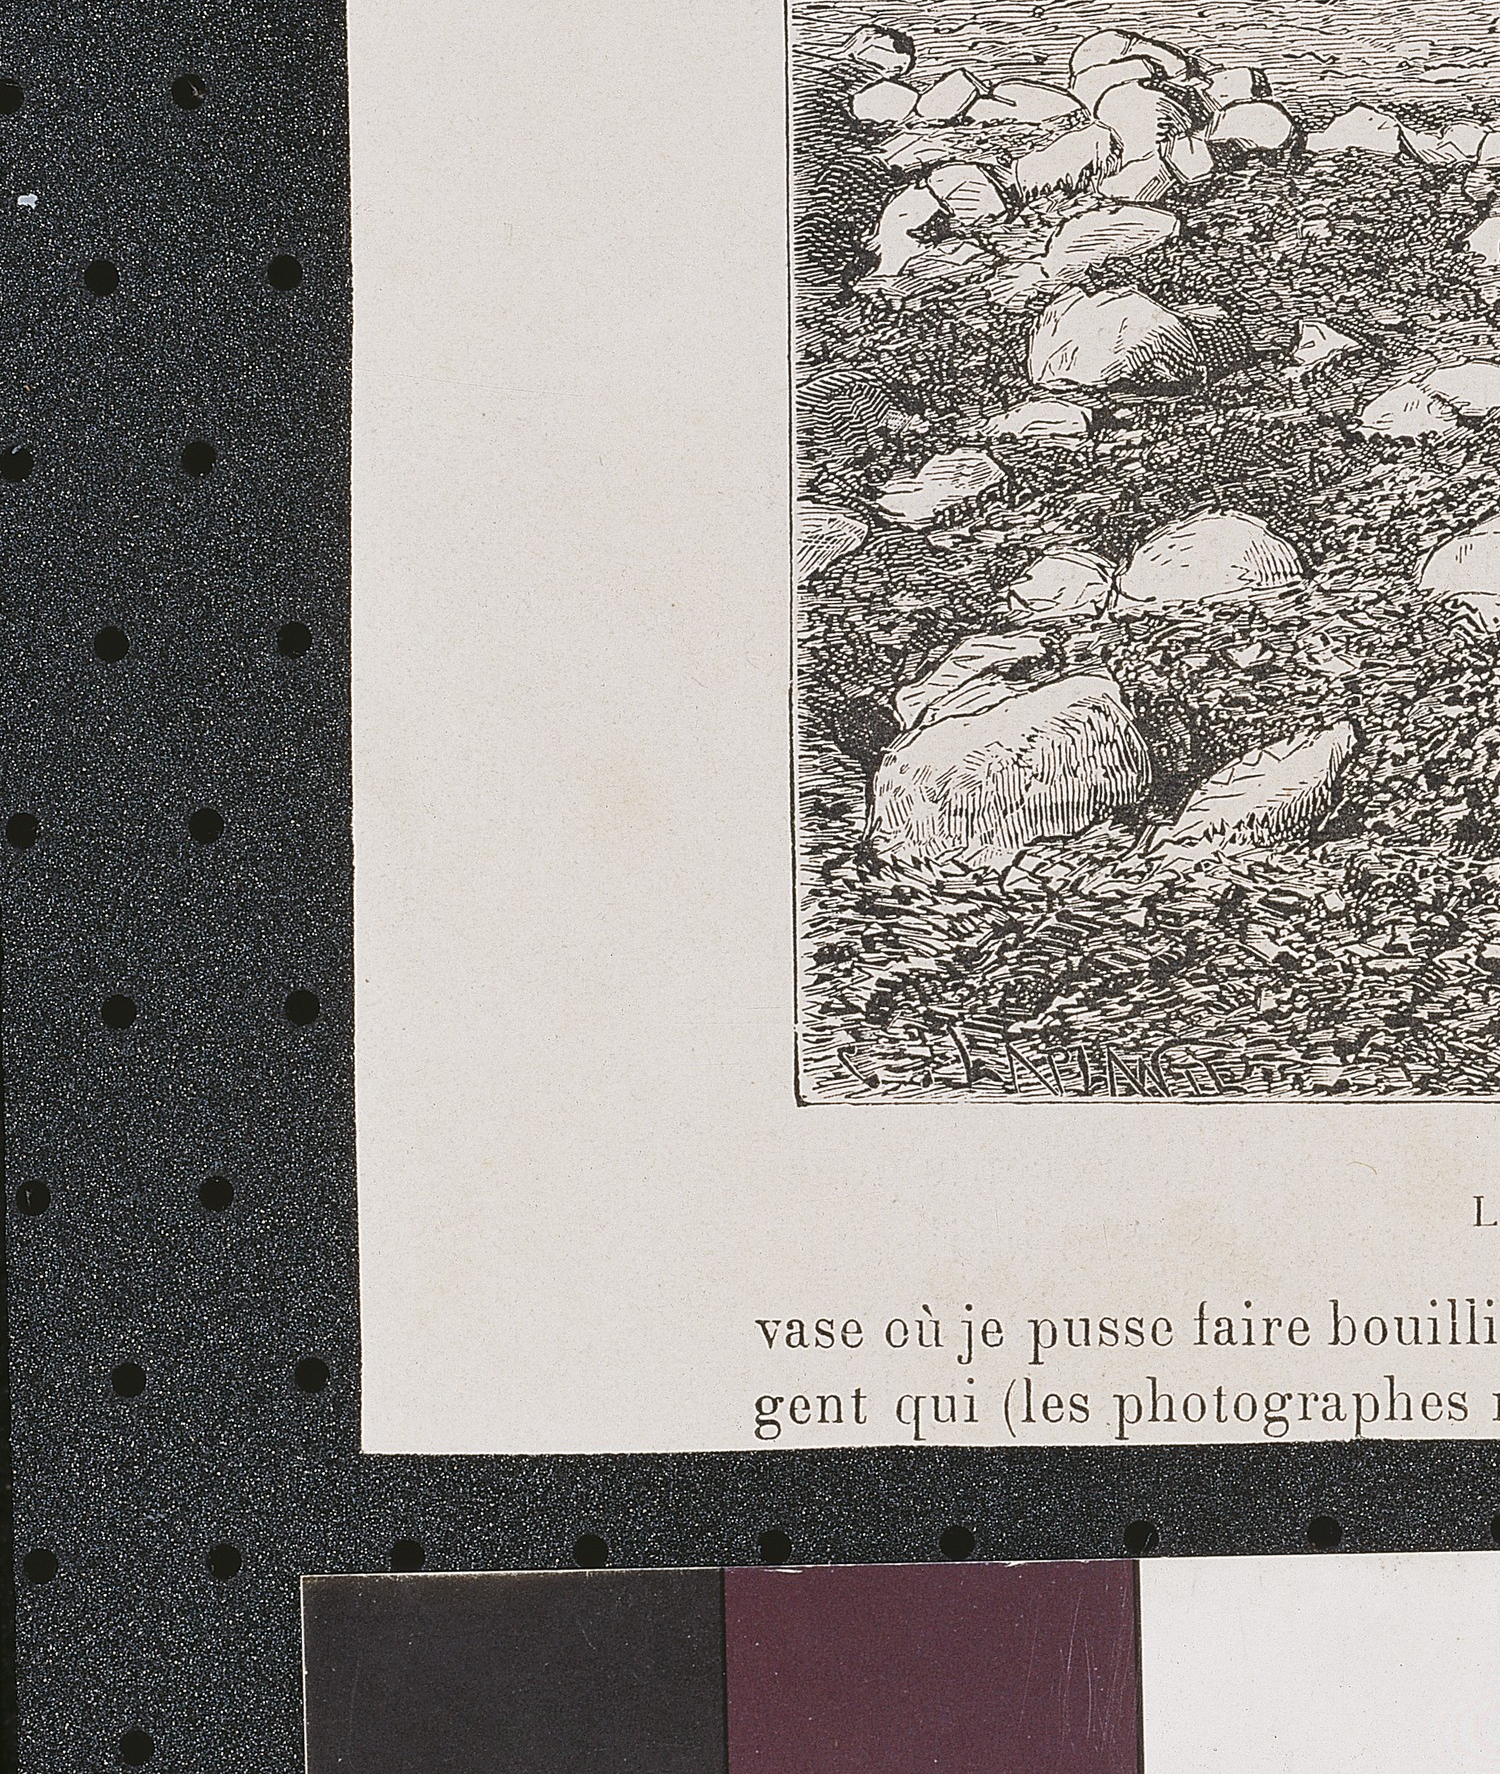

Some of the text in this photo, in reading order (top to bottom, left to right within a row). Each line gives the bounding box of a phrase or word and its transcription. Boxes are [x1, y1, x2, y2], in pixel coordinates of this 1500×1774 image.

[754, 1318, 864, 1350] vase
[885, 1304, 944, 1349] où
[957, 1303, 1004, 1365] je
[1027, 1316, 1173, 1366] pusse
[1193, 1300, 1311, 1347] faire
[754, 1387, 867, 1441] gent
[895, 1377, 979, 1442] qui
[1004, 1377, 1090, 1438] (les
[1112, 1374, 1468, 1441] photographes
